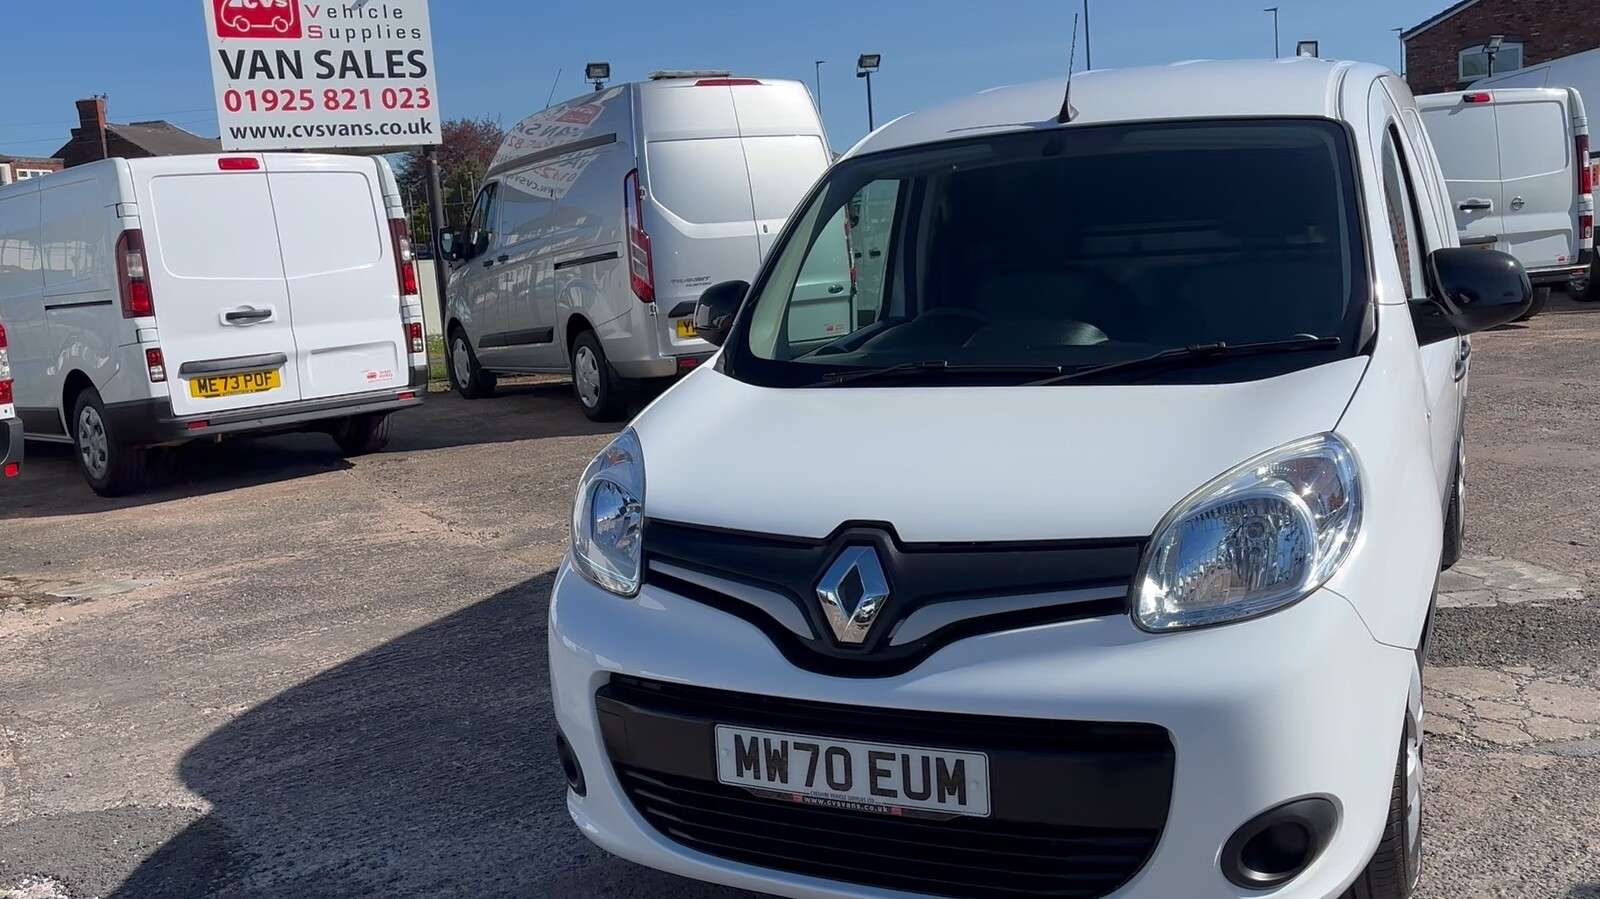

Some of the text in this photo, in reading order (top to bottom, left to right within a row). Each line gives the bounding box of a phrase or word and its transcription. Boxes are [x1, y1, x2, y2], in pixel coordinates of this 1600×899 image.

[305, 4, 403, 19] Vehicle
[308, 24, 422, 43] Supplies
[218, 49, 428, 80] VAN SALES
[223, 87, 431, 113] 01925 821 023
[229, 117, 433, 140] www.cvsvans.co.uk
[198, 375, 240, 394] ME73
[244, 371, 273, 388] POF
[734, 734, 968, 806] MW70 EUM
